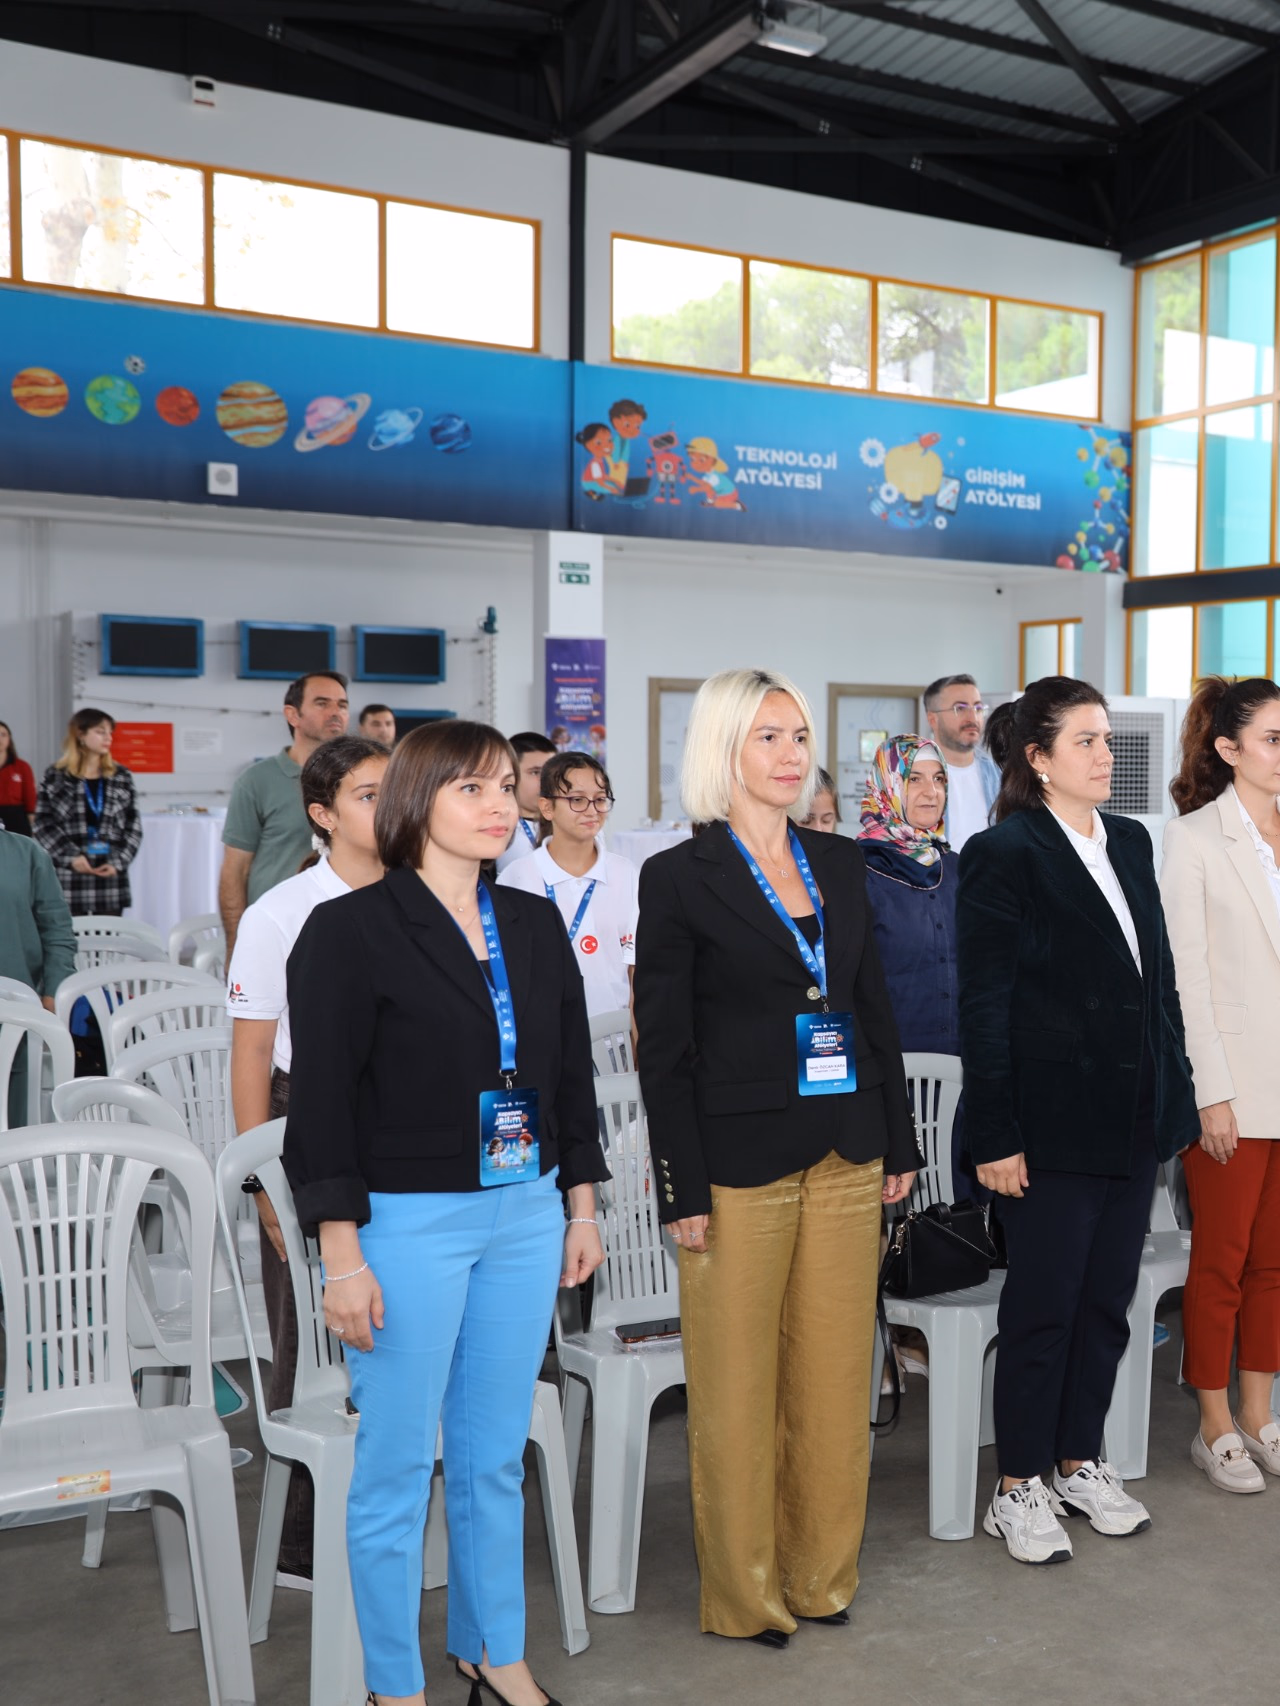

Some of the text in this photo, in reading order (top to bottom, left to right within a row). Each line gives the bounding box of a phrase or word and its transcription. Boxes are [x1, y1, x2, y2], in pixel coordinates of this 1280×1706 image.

[734, 446, 838, 470] TEKNOLOJİ
[734, 468, 823, 490] ATÖLYESİ
[965, 467, 1026, 489] GİRİŞİM
[965, 489, 1042, 511] ATÖLYESİ
[499, 1116, 521, 1125] Bilim
